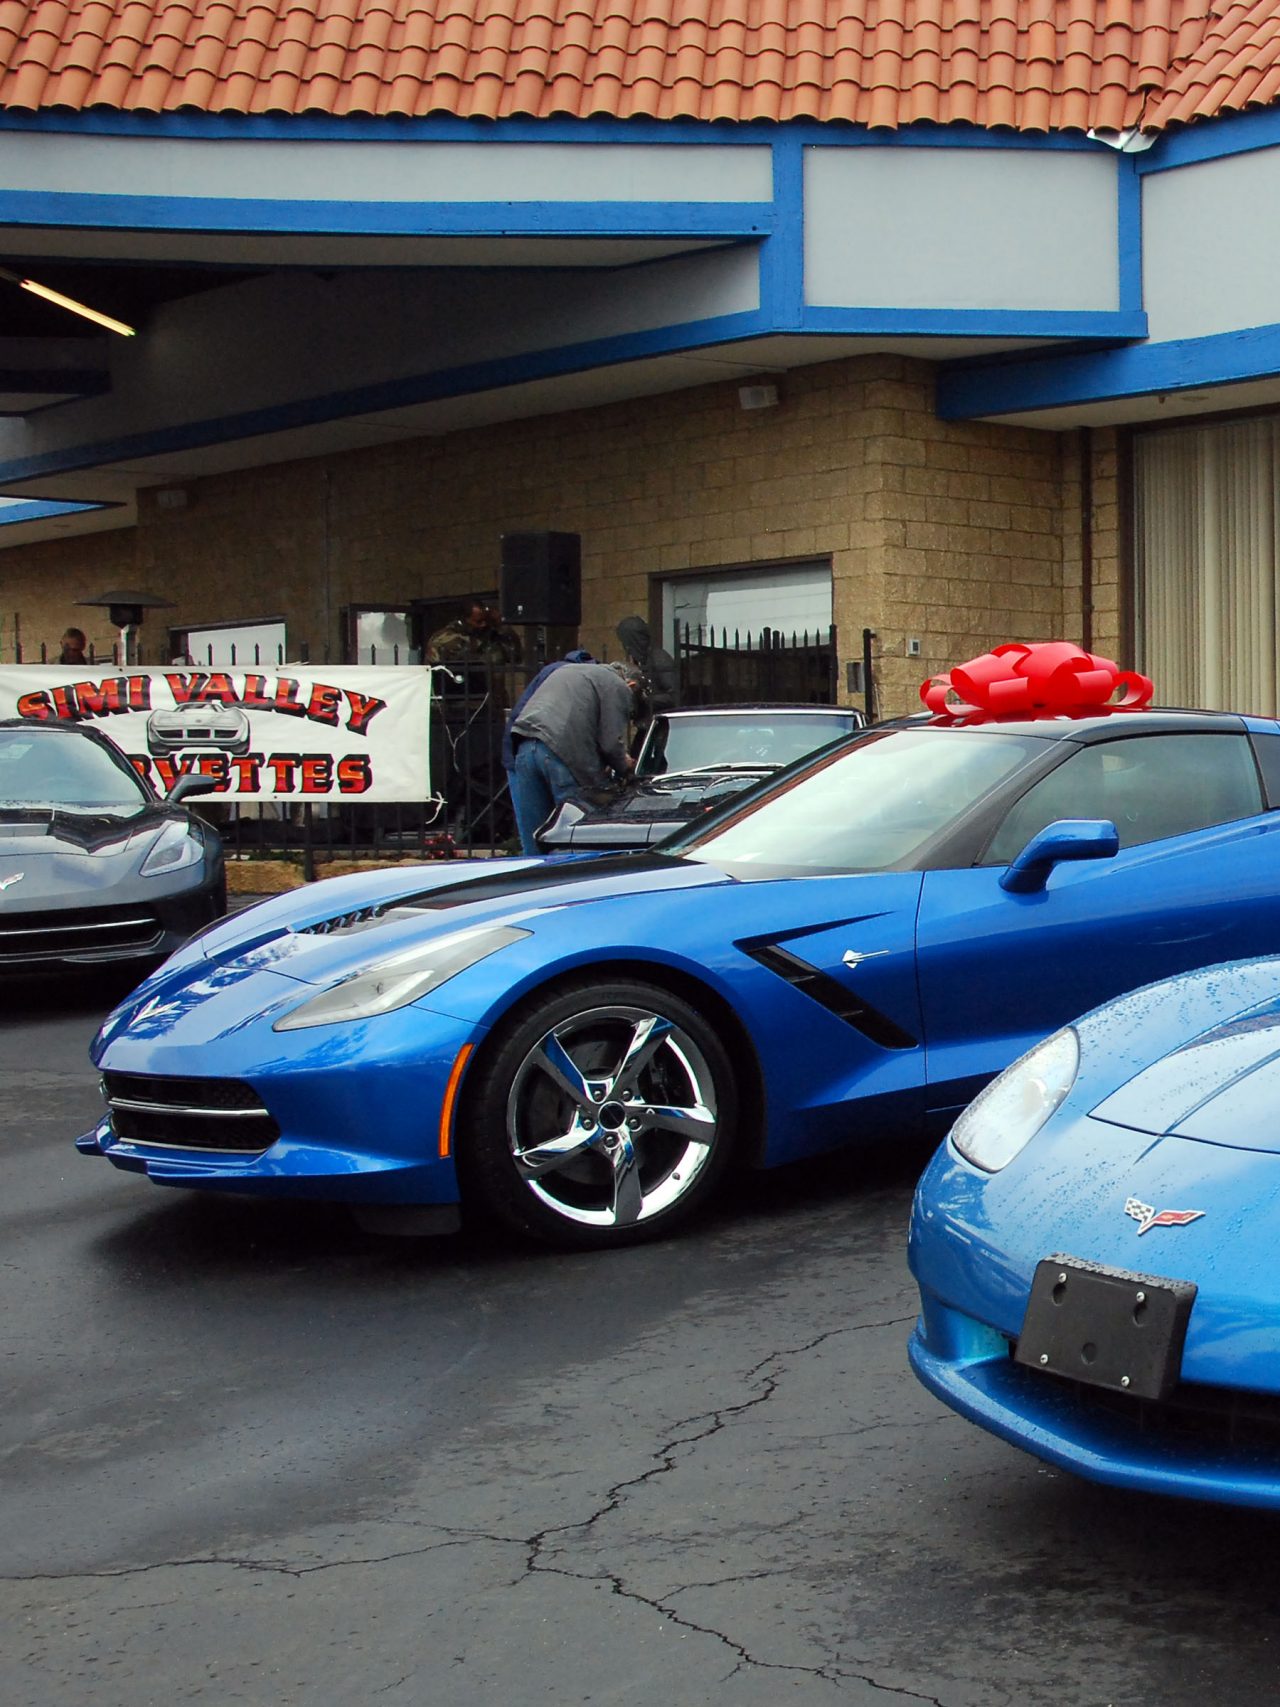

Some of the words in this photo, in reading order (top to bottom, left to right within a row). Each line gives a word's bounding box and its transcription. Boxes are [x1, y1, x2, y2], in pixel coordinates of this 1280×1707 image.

[17, 675, 152, 722] SIMI
[163, 673, 388, 736] VALLEY
[125, 752, 373, 794] RVETTES
